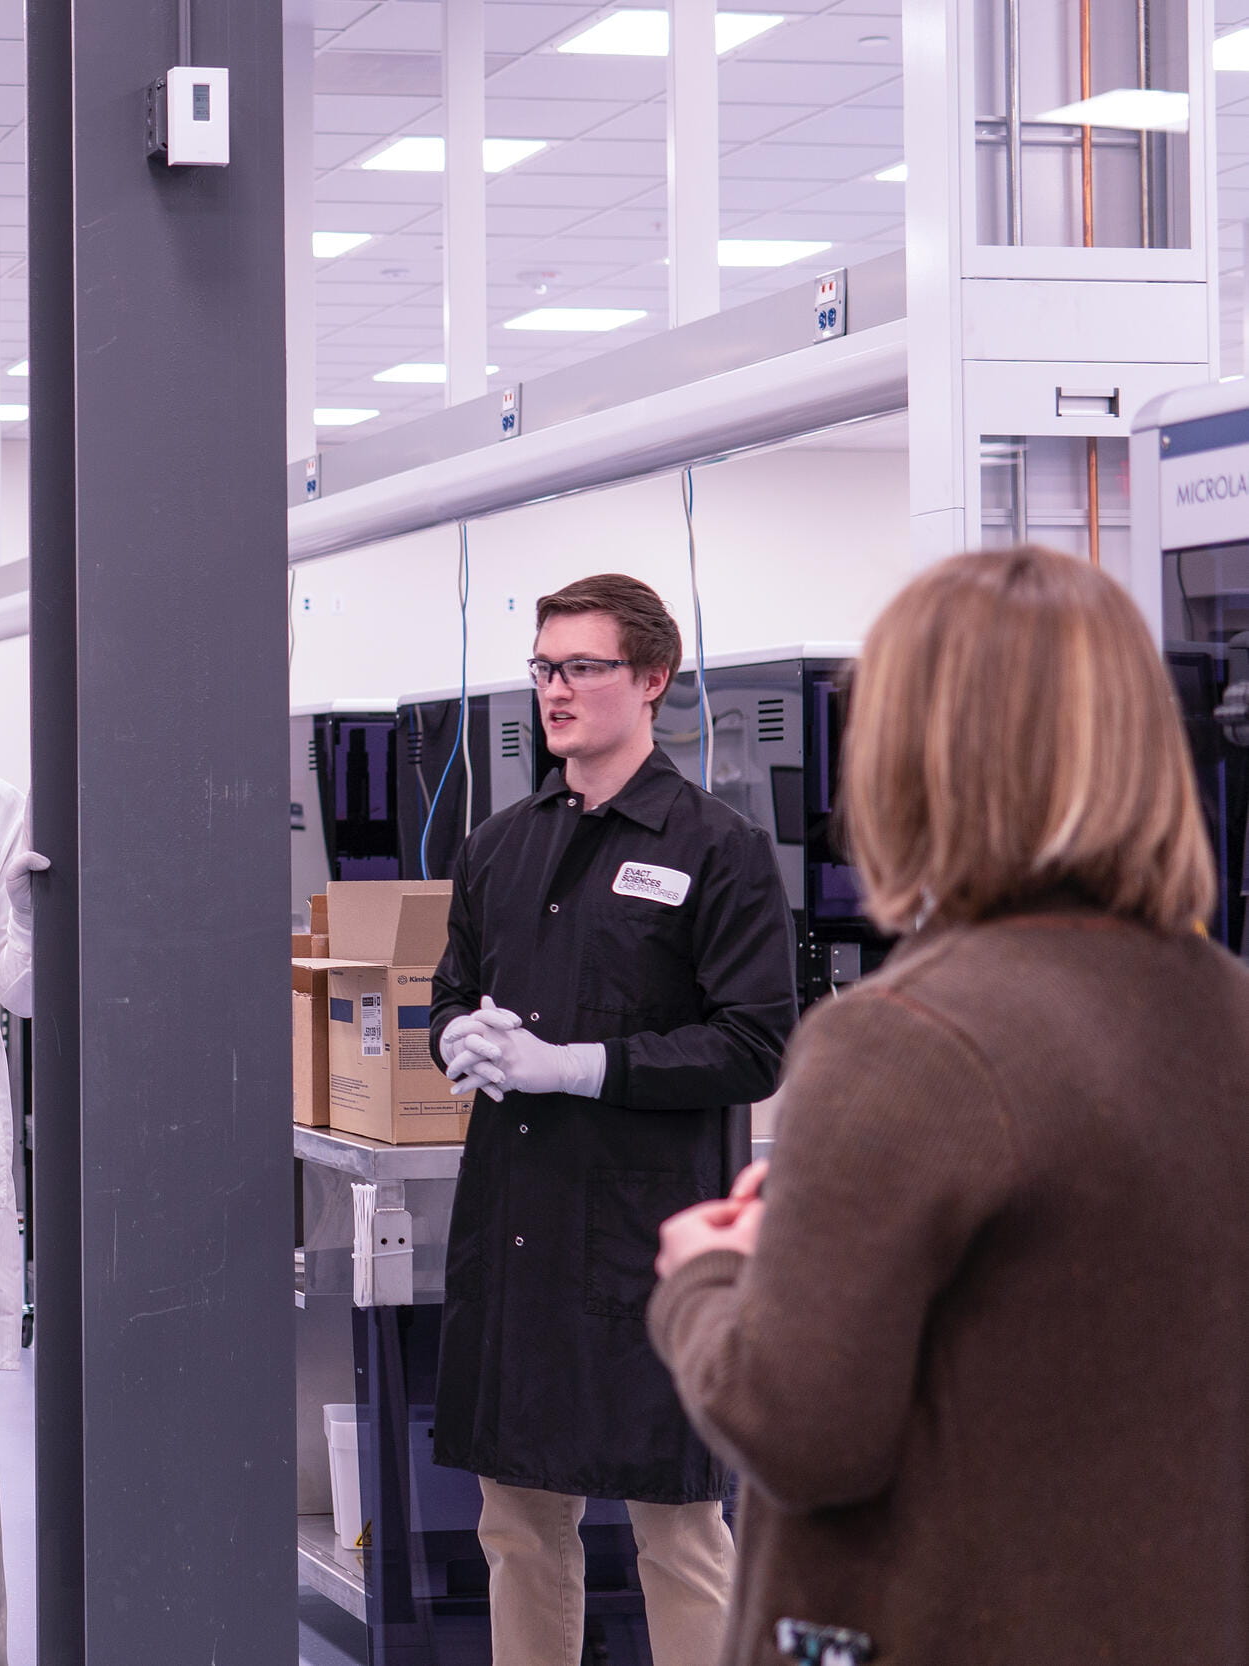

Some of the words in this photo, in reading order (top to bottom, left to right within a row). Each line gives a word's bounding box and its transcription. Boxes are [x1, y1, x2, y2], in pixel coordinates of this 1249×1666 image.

[624, 867, 652, 878] EXACT
[621, 875, 662, 888] SCIENCES
[618, 884, 680, 901] LABORATORIES
[409, 975, 432, 983] Kimbe
